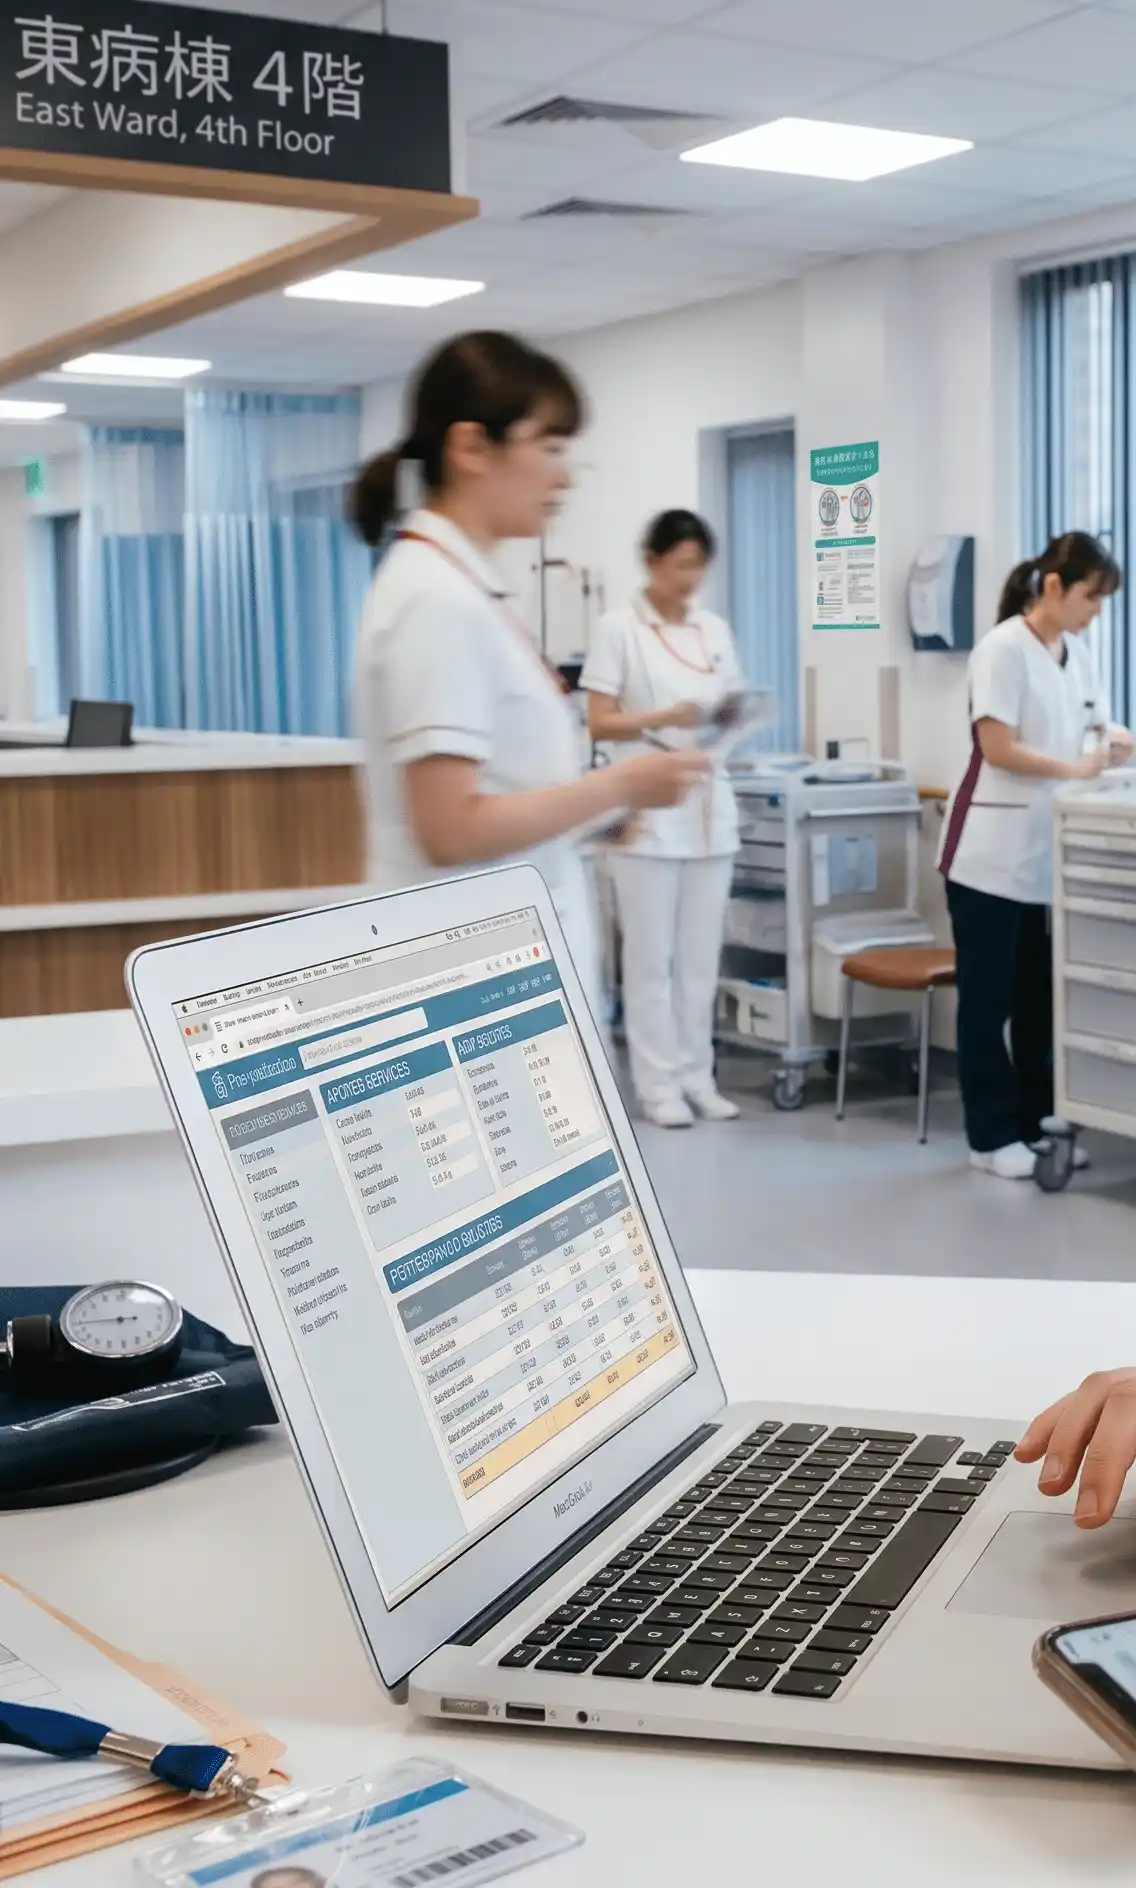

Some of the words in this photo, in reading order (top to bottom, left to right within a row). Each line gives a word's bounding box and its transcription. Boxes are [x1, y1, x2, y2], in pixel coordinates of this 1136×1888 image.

[14, 14, 234, 103] 東病棟
[252, 50, 365, 121] 4階
[15, 92, 84, 129] East
[93, 101, 187, 144] Ward,
[195, 115, 248, 147] 4th
[257, 120, 335, 156] Floor
